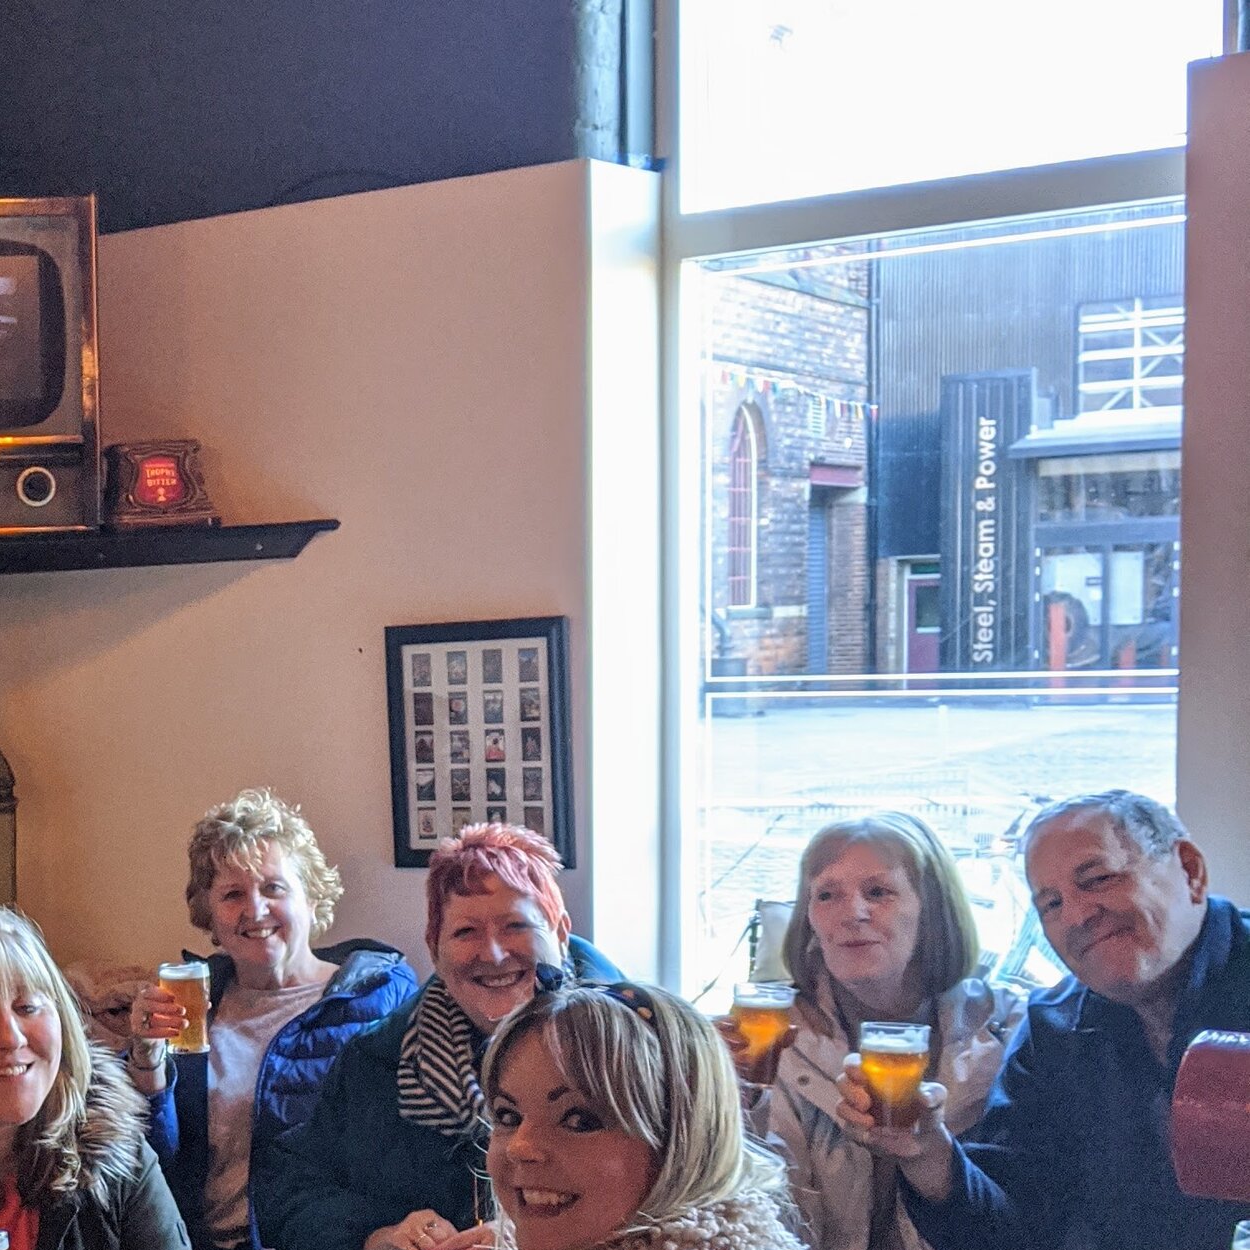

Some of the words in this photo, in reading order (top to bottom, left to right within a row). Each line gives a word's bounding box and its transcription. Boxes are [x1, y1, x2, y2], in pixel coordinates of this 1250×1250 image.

[146, 478, 177, 487] BITTER
[974, 416, 997, 490] Power
[975, 496, 996, 512] &
[973, 518, 996, 593] Steam
[972, 599, 997, 662] Steel,
